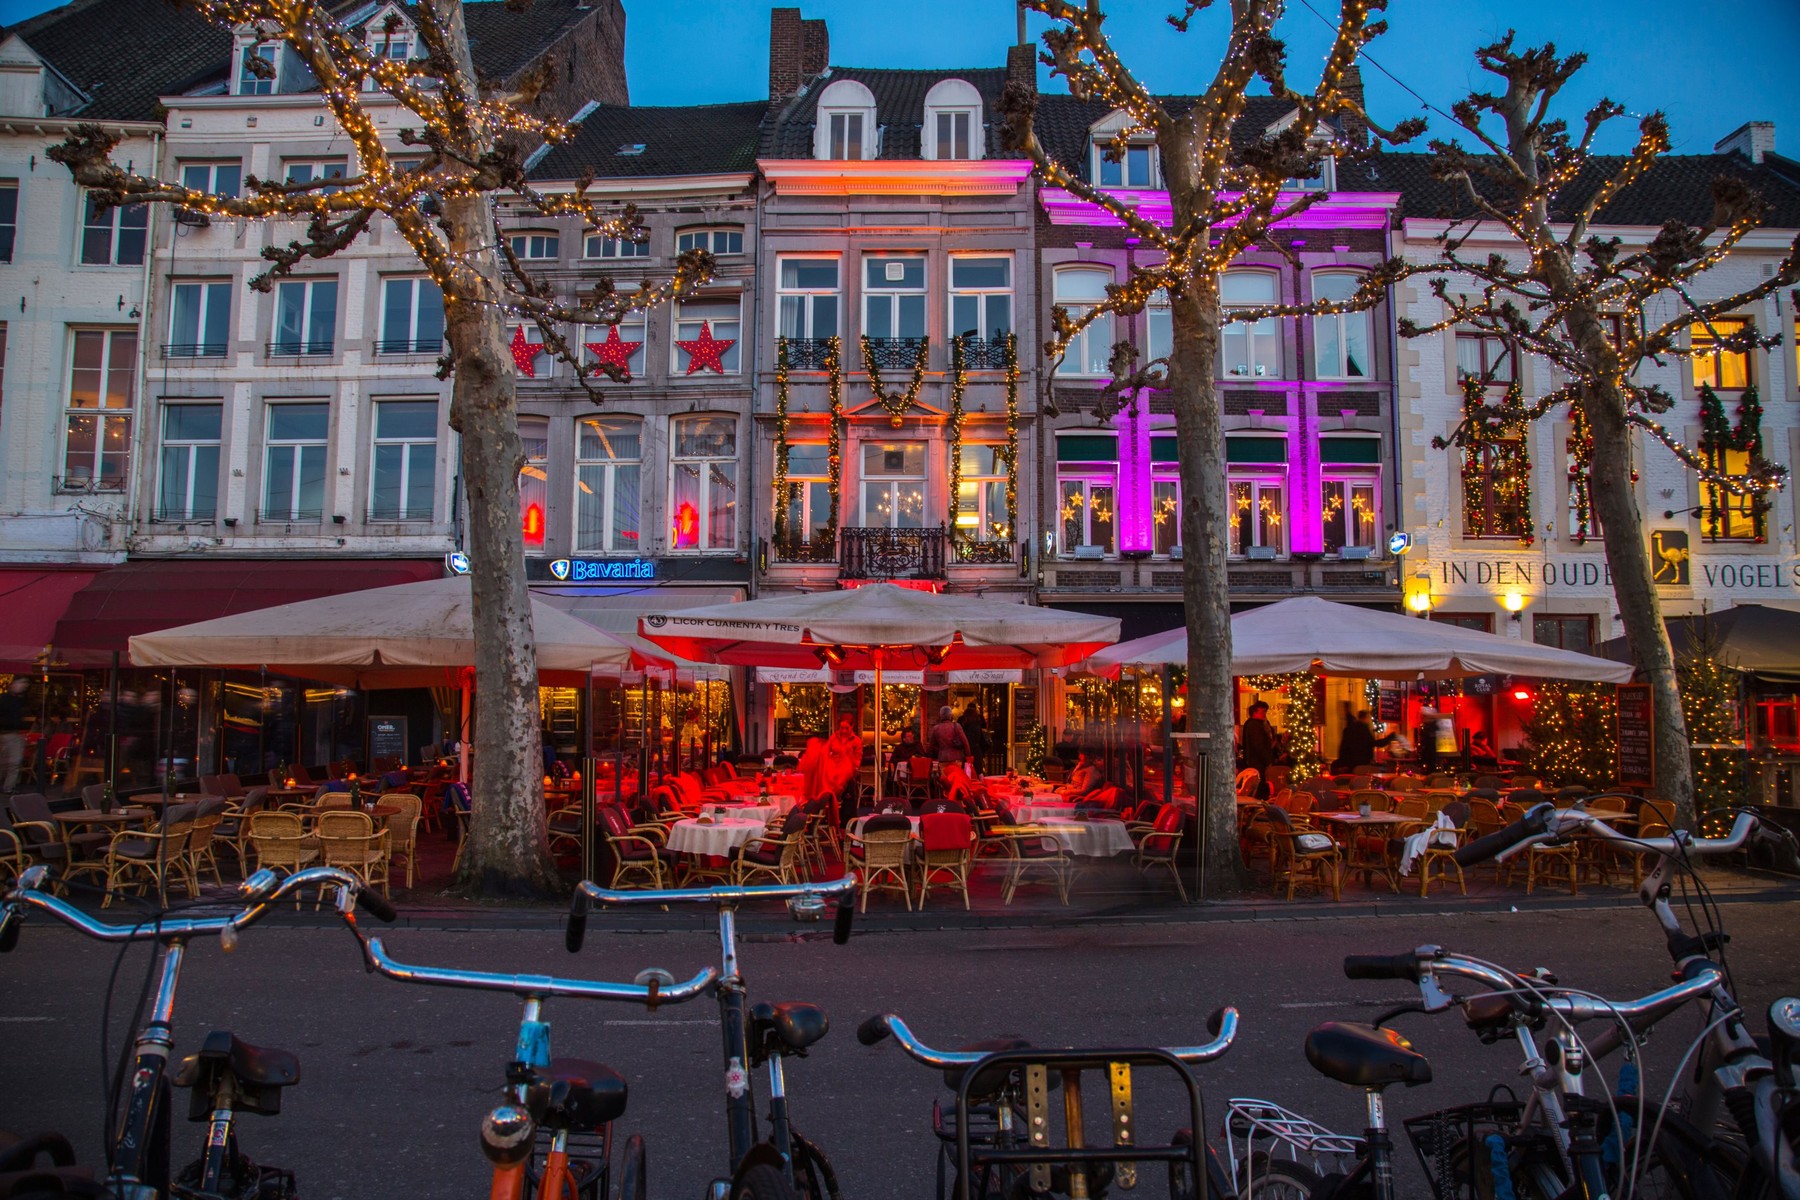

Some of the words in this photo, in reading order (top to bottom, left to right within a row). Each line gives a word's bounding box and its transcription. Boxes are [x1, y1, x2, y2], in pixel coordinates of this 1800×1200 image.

[572, 559, 655, 580] Bavaria
[1442, 561, 1468, 584] IN
[1477, 561, 1532, 585] DEN
[672, 617, 705, 627] LICOR
[706, 618, 762, 630] CUARENTA
[773, 622, 800, 632] TRES
[769, 671, 797, 681] Grand
